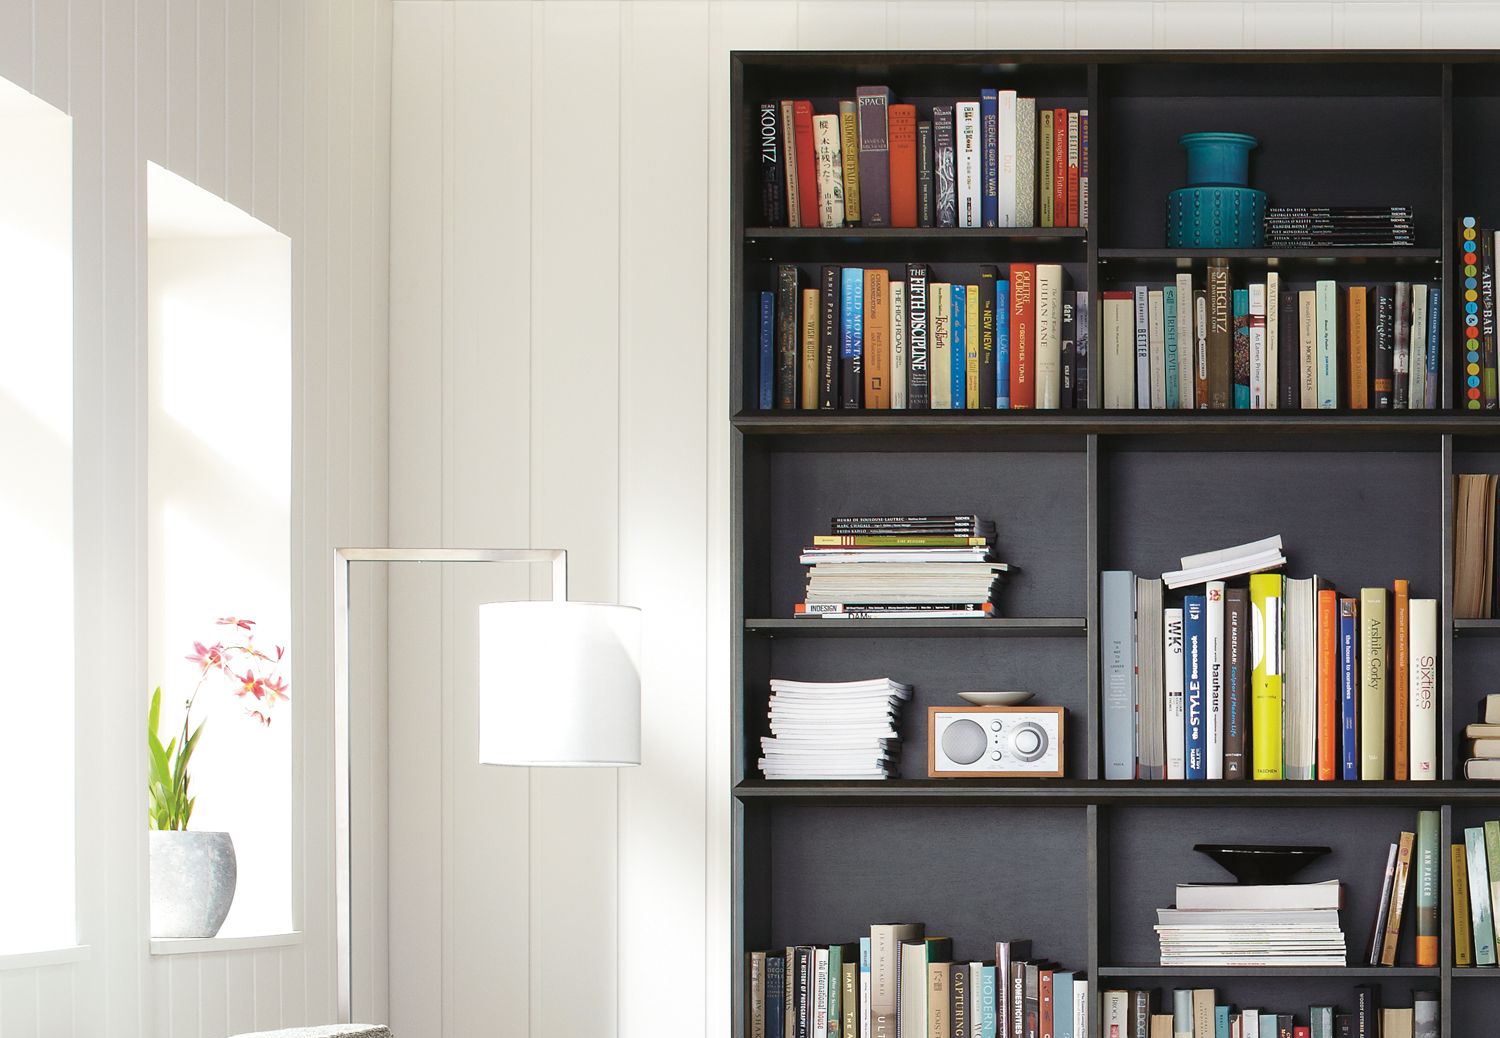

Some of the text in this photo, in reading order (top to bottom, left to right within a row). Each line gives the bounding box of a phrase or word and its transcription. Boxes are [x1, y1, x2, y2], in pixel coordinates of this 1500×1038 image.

[761, 109, 776, 163] KOONTZ
[988, 115, 996, 147] SCIENCE
[988, 178, 996, 197] WAR
[989, 168, 995, 176] TO
[910, 277, 927, 309] FIFTH
[1014, 271, 1023, 316] JOURDAIN
[1040, 279, 1048, 316] JULIAN
[1064, 304, 1073, 323] dark
[1216, 271, 1227, 333] STIEGLITZ
[1482, 271, 1493, 335] ART BAR
[853, 279, 862, 373] COLD MOUNTAIN
[910, 312, 927, 371] DISCIPLINE
[1138, 328, 1146, 358] BETTER
[1167, 316, 1177, 372] IRISH DEVIL
[1376, 296, 1386, 350] Mockingbird
[1368, 618, 1382, 690] Arshile Gorky
[1189, 681, 1200, 726] STYLE
[1212, 663, 1221, 713] bauhaus
[1420, 655, 1434, 710] Sixties
[1423, 867, 1431, 897] PACKER
[754, 999, 761, 1011] BY
[816, 960, 828, 1030] the international house
[955, 972, 964, 1036] CAPTURING
[983, 975, 993, 1030] MODERN
[1014, 978, 1022, 1035] DOMESTICITIES
